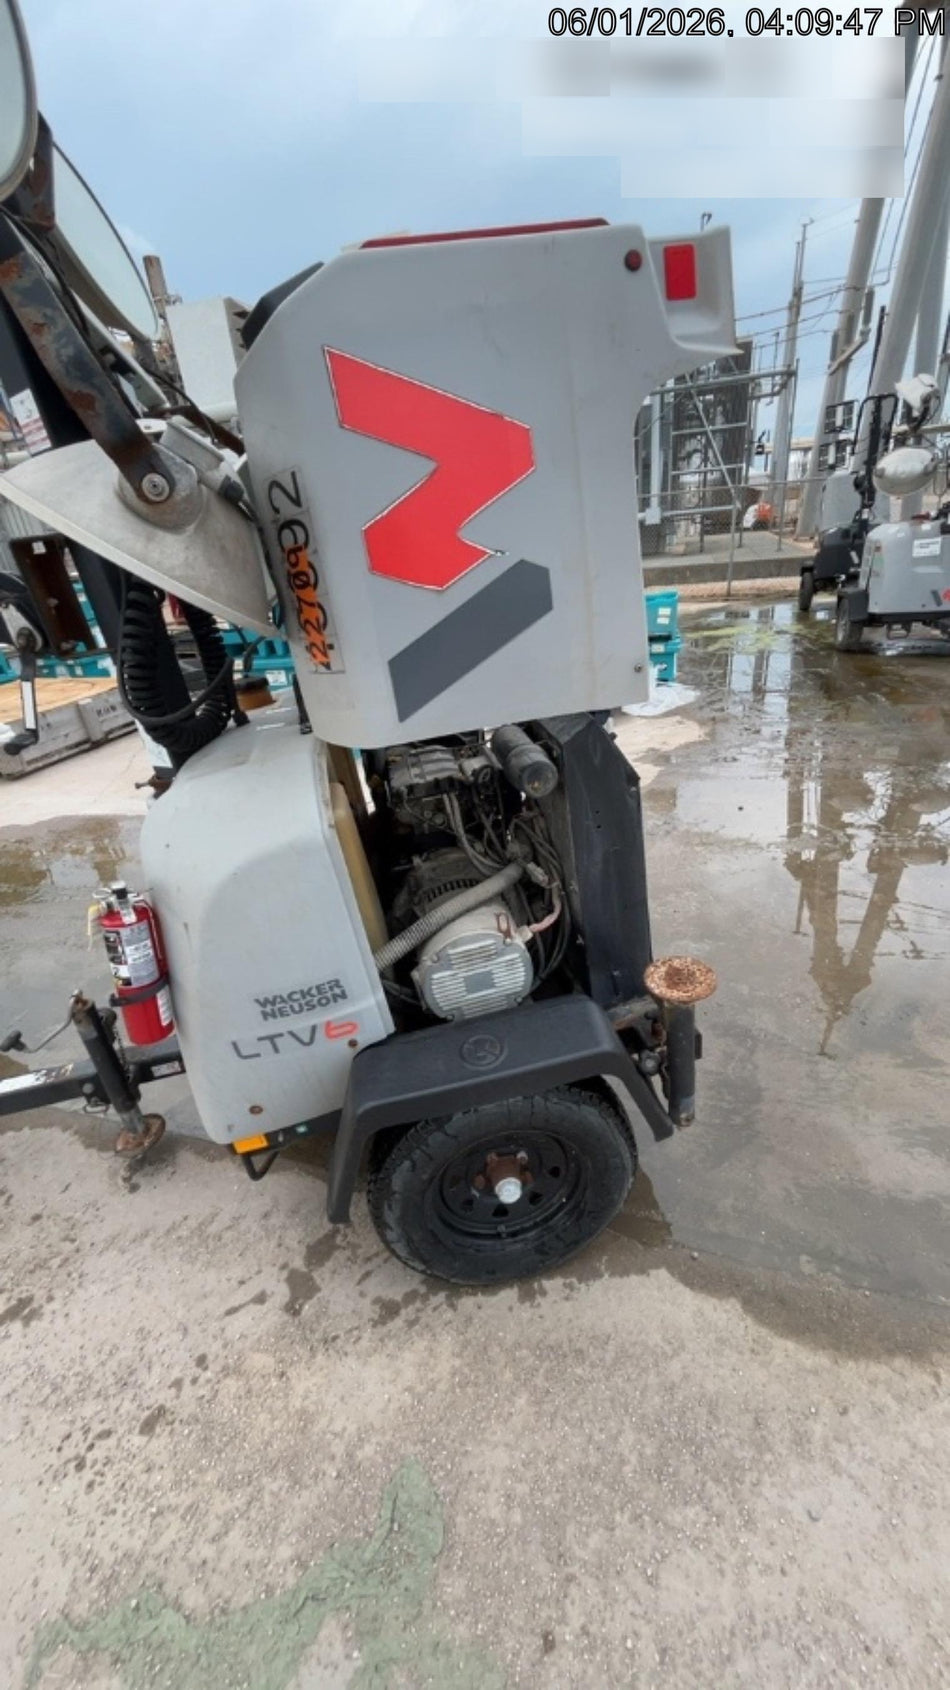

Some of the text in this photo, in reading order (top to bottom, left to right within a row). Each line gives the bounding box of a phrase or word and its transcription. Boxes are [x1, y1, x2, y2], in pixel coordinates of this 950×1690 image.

[254, 978, 344, 1009] WACKER
[260, 988, 348, 1021] NEUSON
[230, 1020, 358, 1060] LTV6
